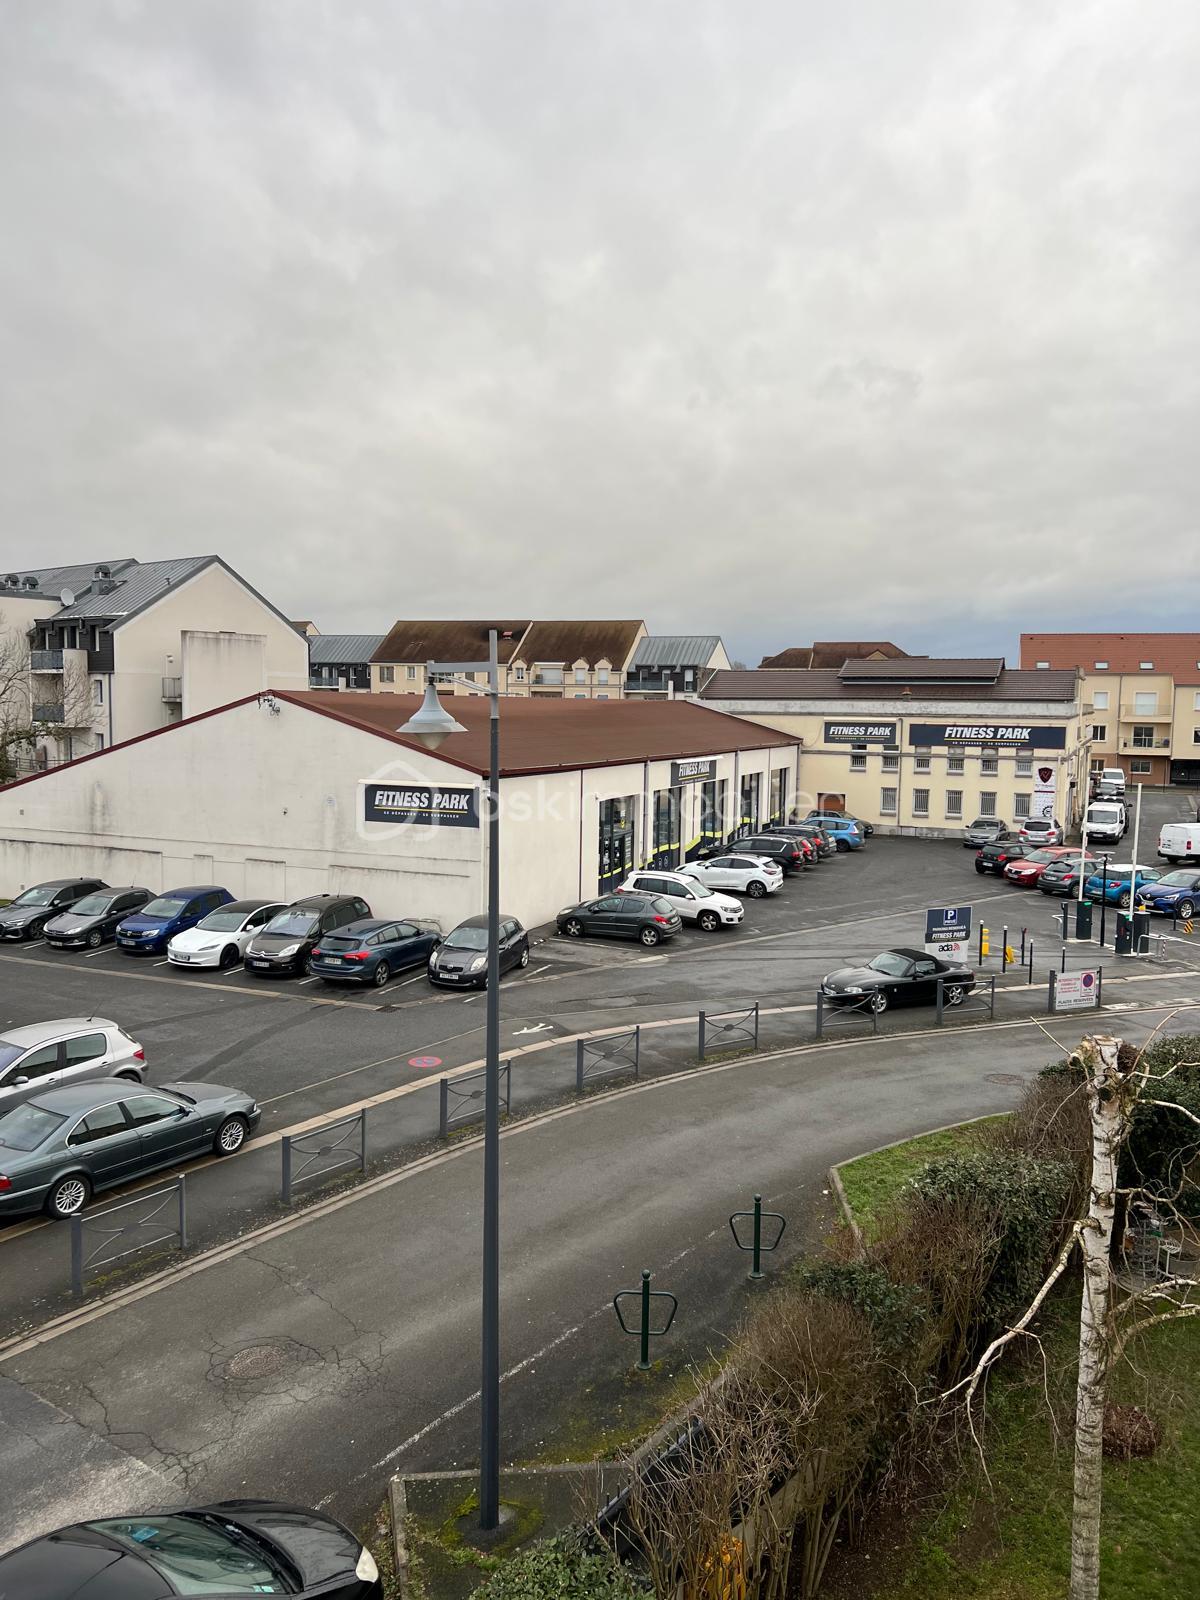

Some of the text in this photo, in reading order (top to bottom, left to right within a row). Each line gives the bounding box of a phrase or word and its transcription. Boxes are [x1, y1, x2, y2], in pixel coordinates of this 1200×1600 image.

[829, 726, 892, 736] FITNESS PARK
[944, 727, 1032, 739] FITNESS PARK
[679, 761, 711, 777] FITNESS PARK
[374, 790, 470, 810] FITNESS PARK
[947, 910, 955, 920] P
[938, 943, 953, 953] ada
